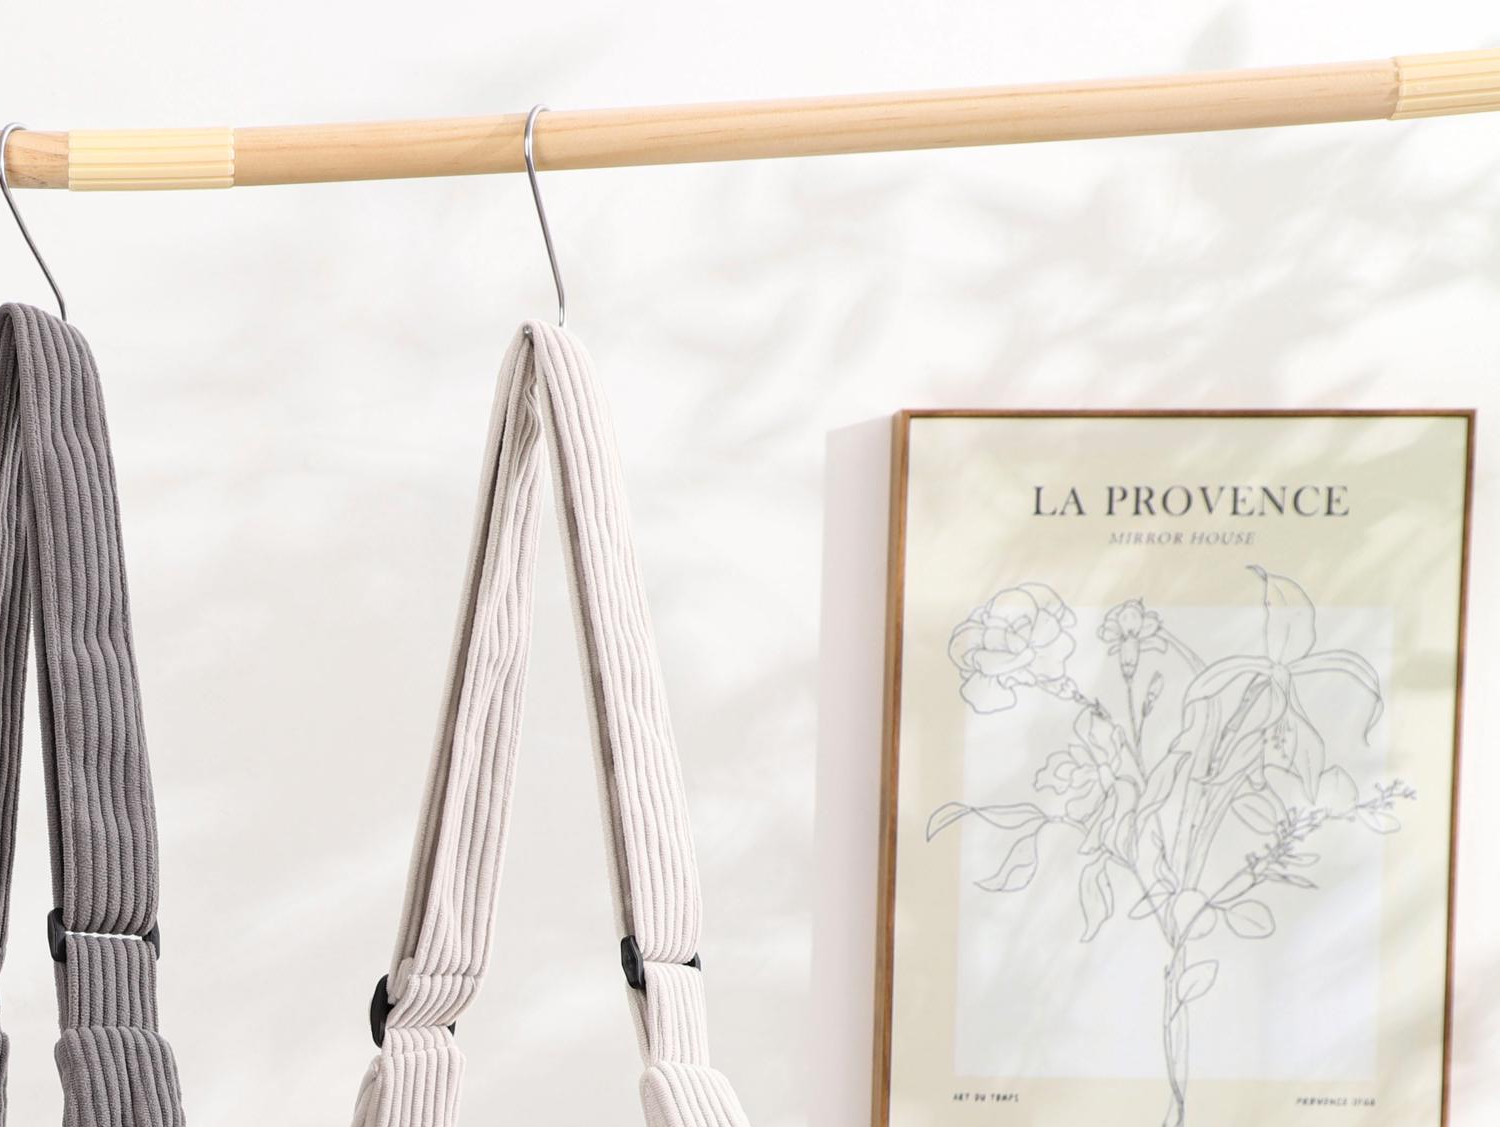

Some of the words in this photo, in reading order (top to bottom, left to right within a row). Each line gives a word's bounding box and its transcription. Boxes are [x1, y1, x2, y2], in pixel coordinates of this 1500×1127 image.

[1032, 485, 1087, 517] LA
[1105, 485, 1350, 517] PROVENCE
[1108, 531, 1184, 546] MIRROR
[1190, 531, 1256, 546] HOUSE
